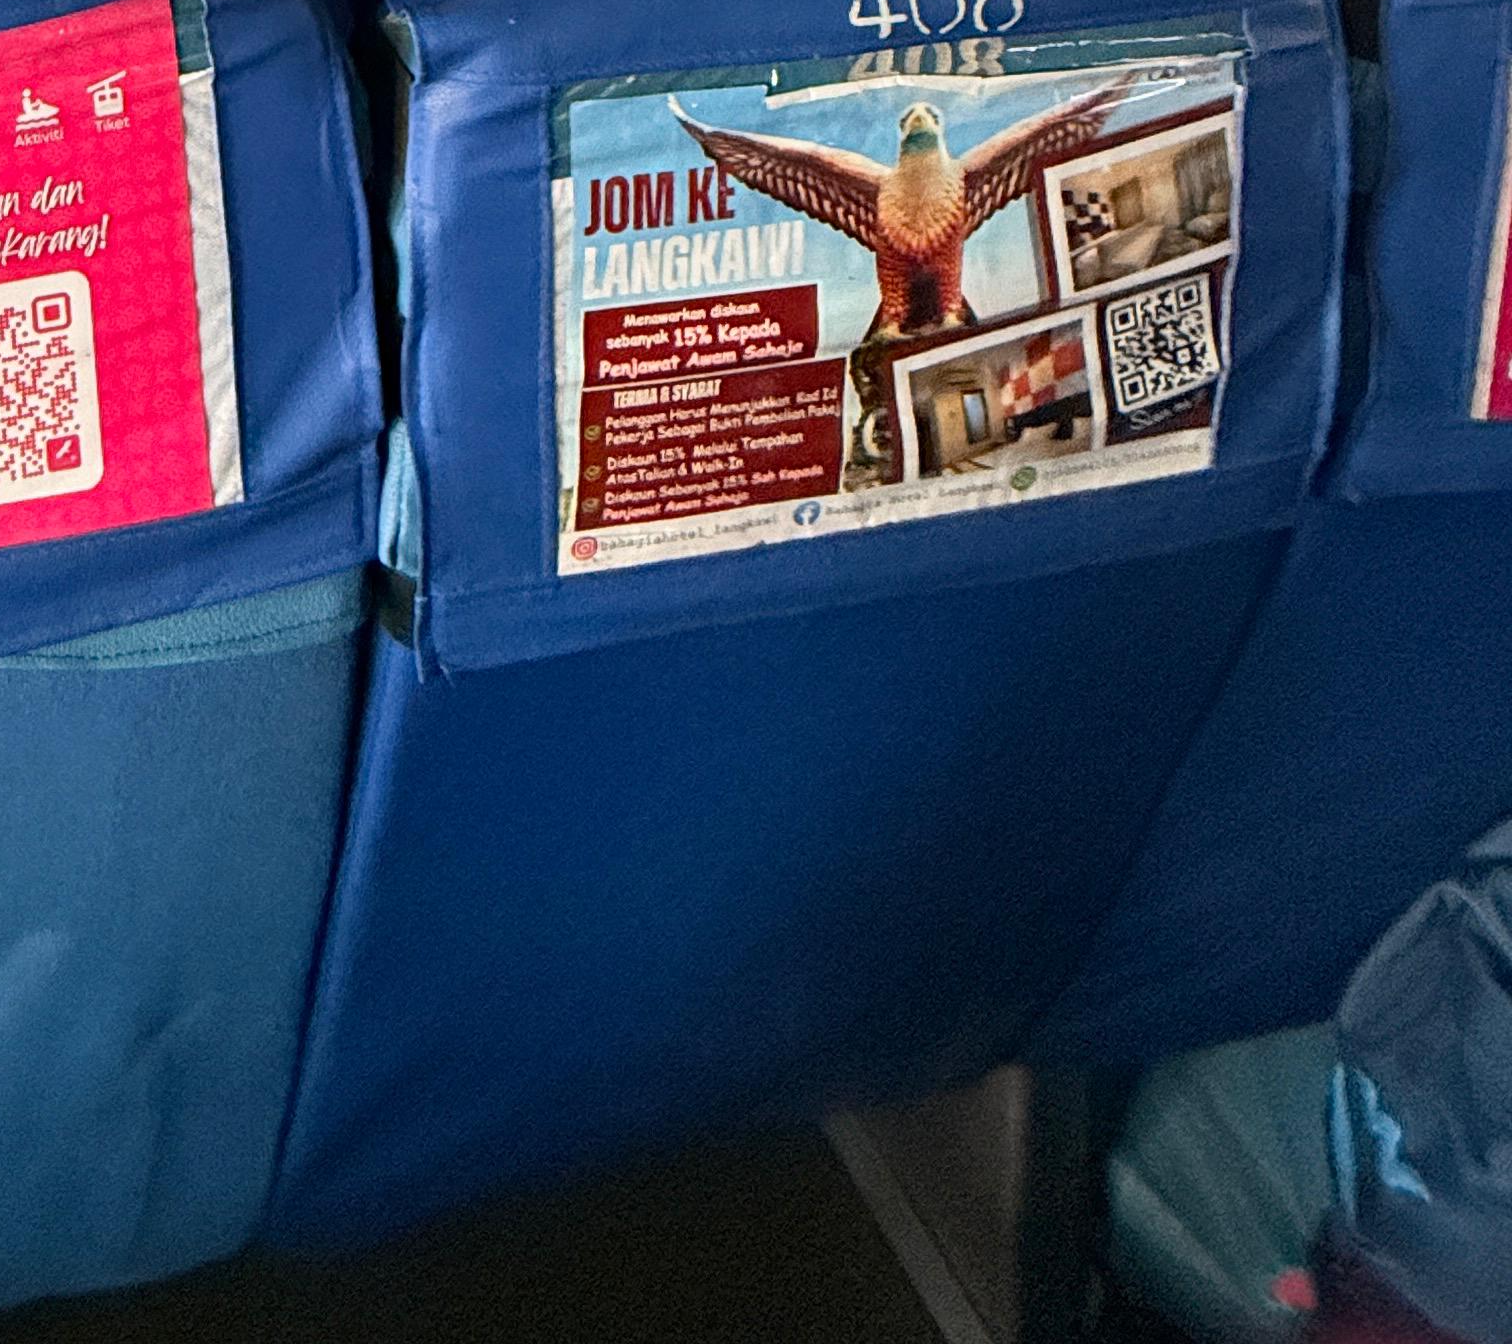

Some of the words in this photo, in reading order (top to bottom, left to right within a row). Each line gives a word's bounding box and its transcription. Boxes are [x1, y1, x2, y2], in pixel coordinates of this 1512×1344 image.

[14, 127, 66, 149] Aktiviti
[94, 114, 132, 133] Tiket
[29, 175, 86, 215] dan
[584, 170, 675, 237] JOM
[687, 161, 737, 224] KE
[582, 219, 806, 300] LANGKAWI
[622, 306, 707, 328] Menawarkan
[710, 300, 761, 319] diskaun
[605, 328, 670, 350] sebanyak
[673, 324, 713, 349] 15%
[717, 317, 781, 347] Kepada
[598, 354, 681, 380] Penjawat
[686, 348, 737, 369] Awam
[742, 338, 805, 362] Sahaja
[613, 387, 658, 409] TERMA
[671, 378, 723, 402] SYARAT
[607, 454, 658, 471] Diskaun
